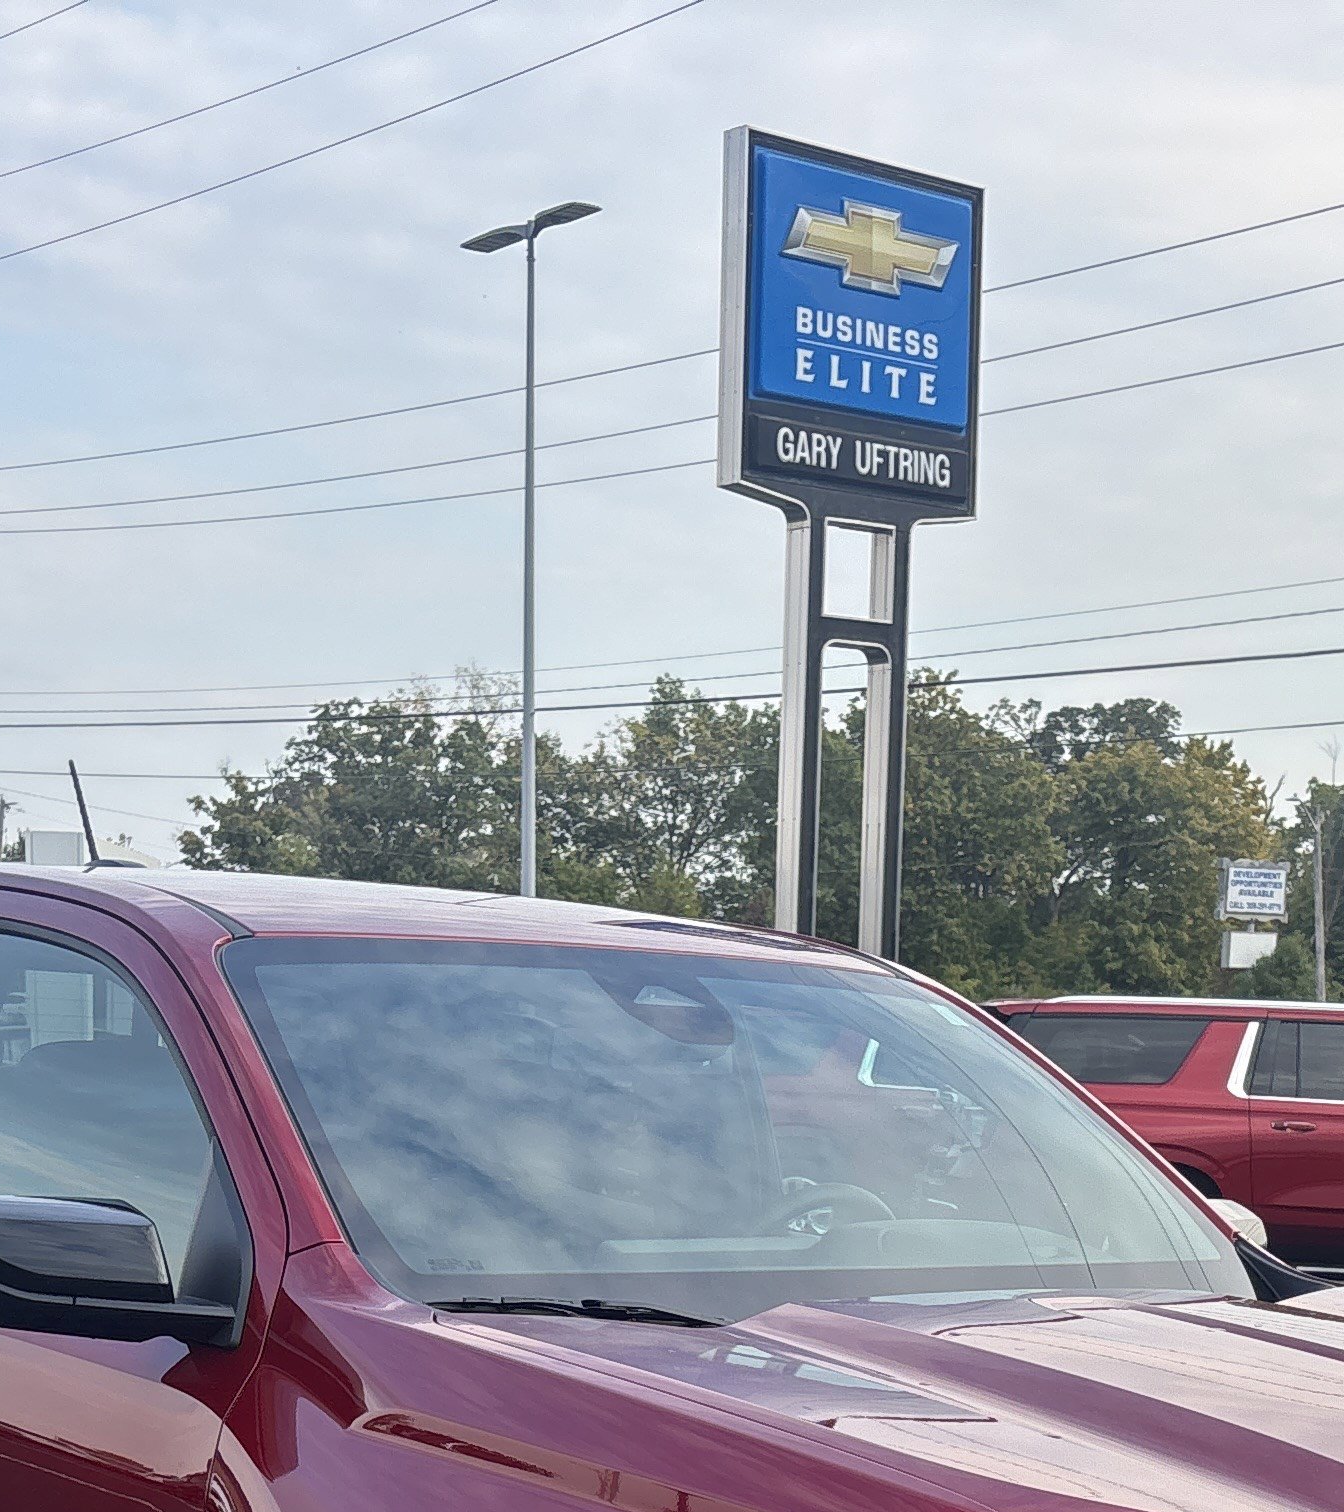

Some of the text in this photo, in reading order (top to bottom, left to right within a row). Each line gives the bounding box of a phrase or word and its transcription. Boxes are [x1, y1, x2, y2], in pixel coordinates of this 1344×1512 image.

[795, 305, 939, 361] BUSINESS
[794, 347, 939, 406] ELITE
[776, 426, 952, 489] GARY UFTRING
